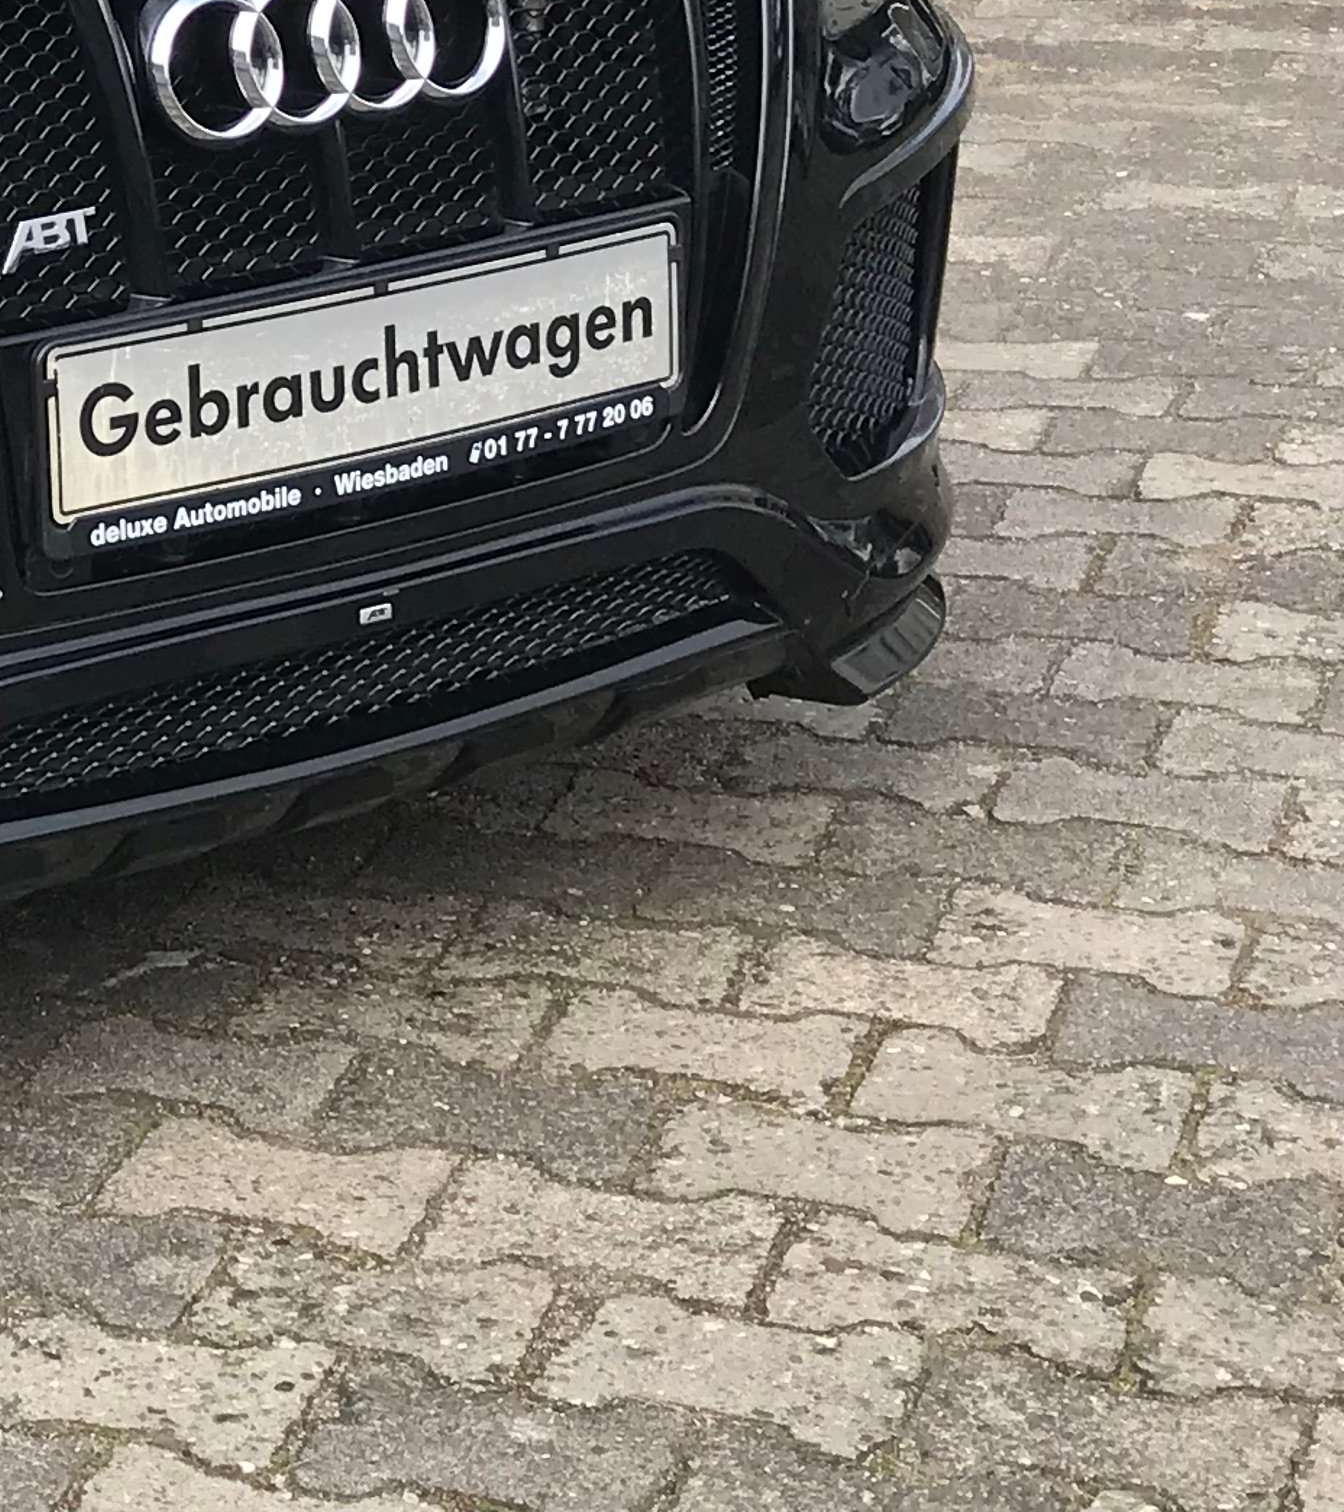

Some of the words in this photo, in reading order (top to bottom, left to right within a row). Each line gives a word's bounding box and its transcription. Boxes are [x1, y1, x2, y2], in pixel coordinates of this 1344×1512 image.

[2, 206, 96, 275] ABT
[79, 296, 653, 457] Gebrauchtwagen
[90, 516, 168, 546] deluxe
[173, 486, 302, 530] Automobile
[333, 455, 448, 495] Wiesbaden
